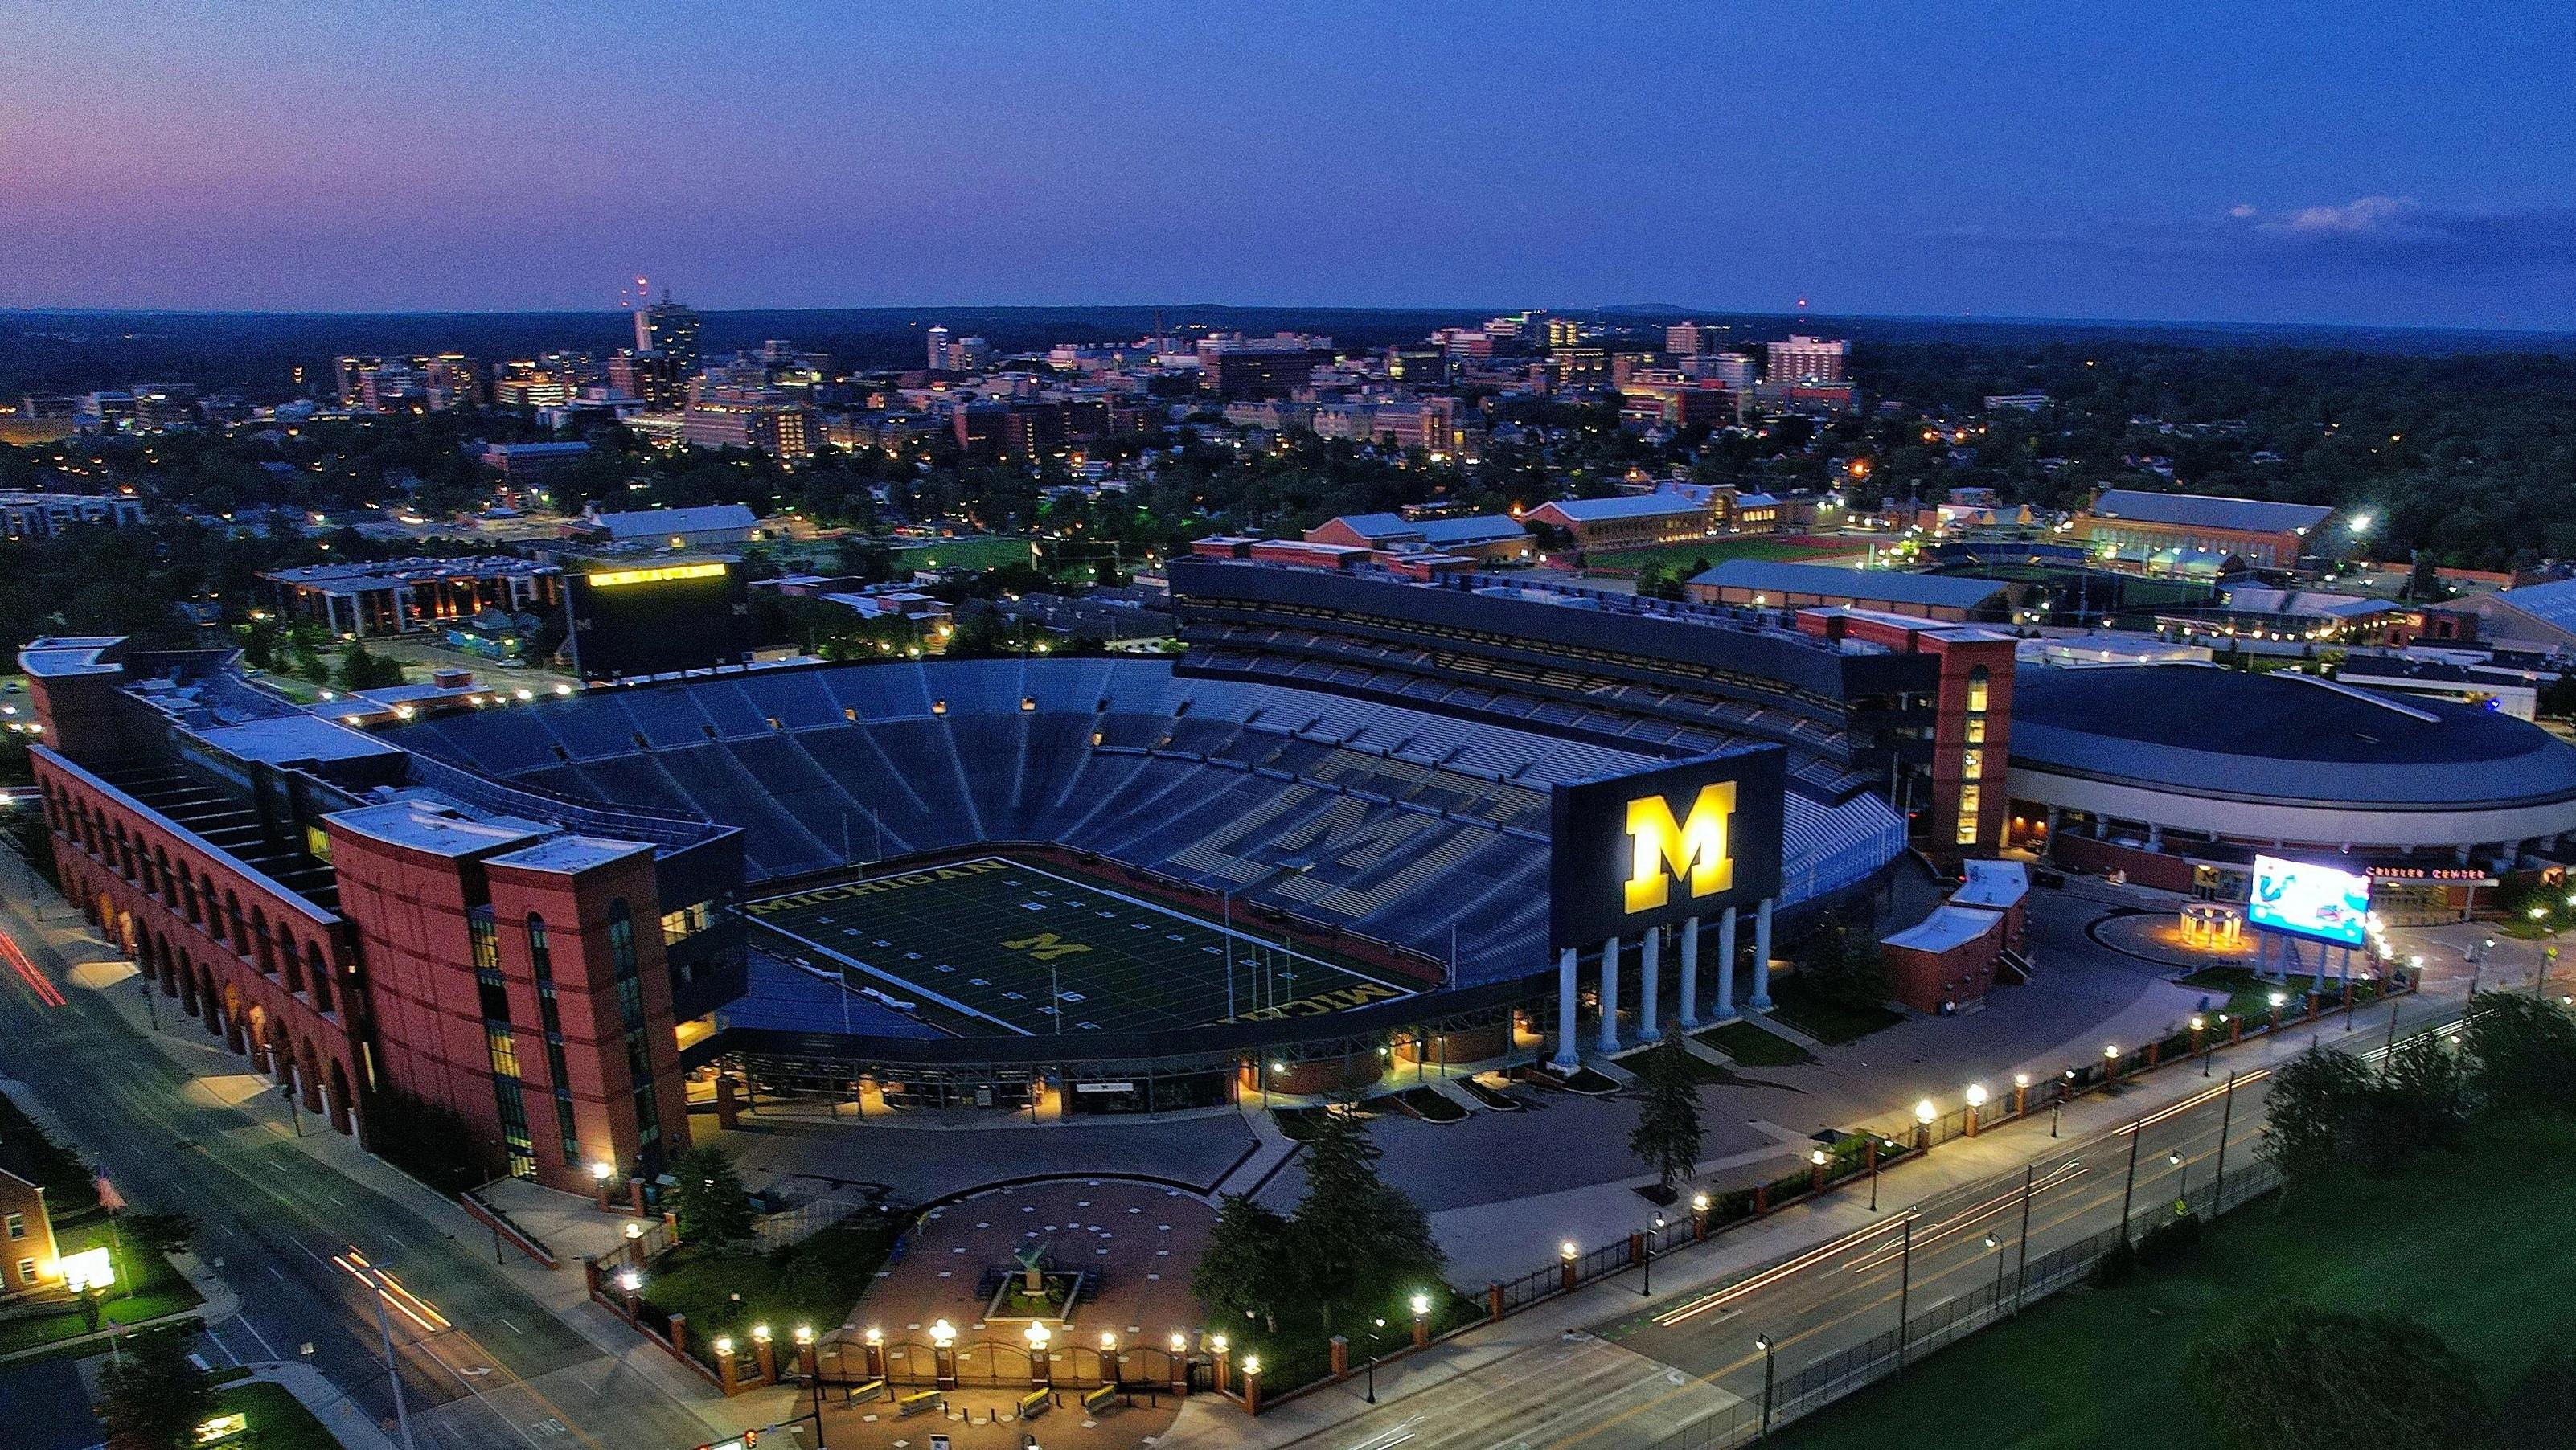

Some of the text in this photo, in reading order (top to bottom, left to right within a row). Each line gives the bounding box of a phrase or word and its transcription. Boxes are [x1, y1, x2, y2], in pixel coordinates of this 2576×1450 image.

[1624, 780, 1737, 915] M
[744, 860, 1010, 915] MICHIGAN
[2365, 866, 2485, 879] CRISLER CENTER
[999, 932, 1093, 961] M
